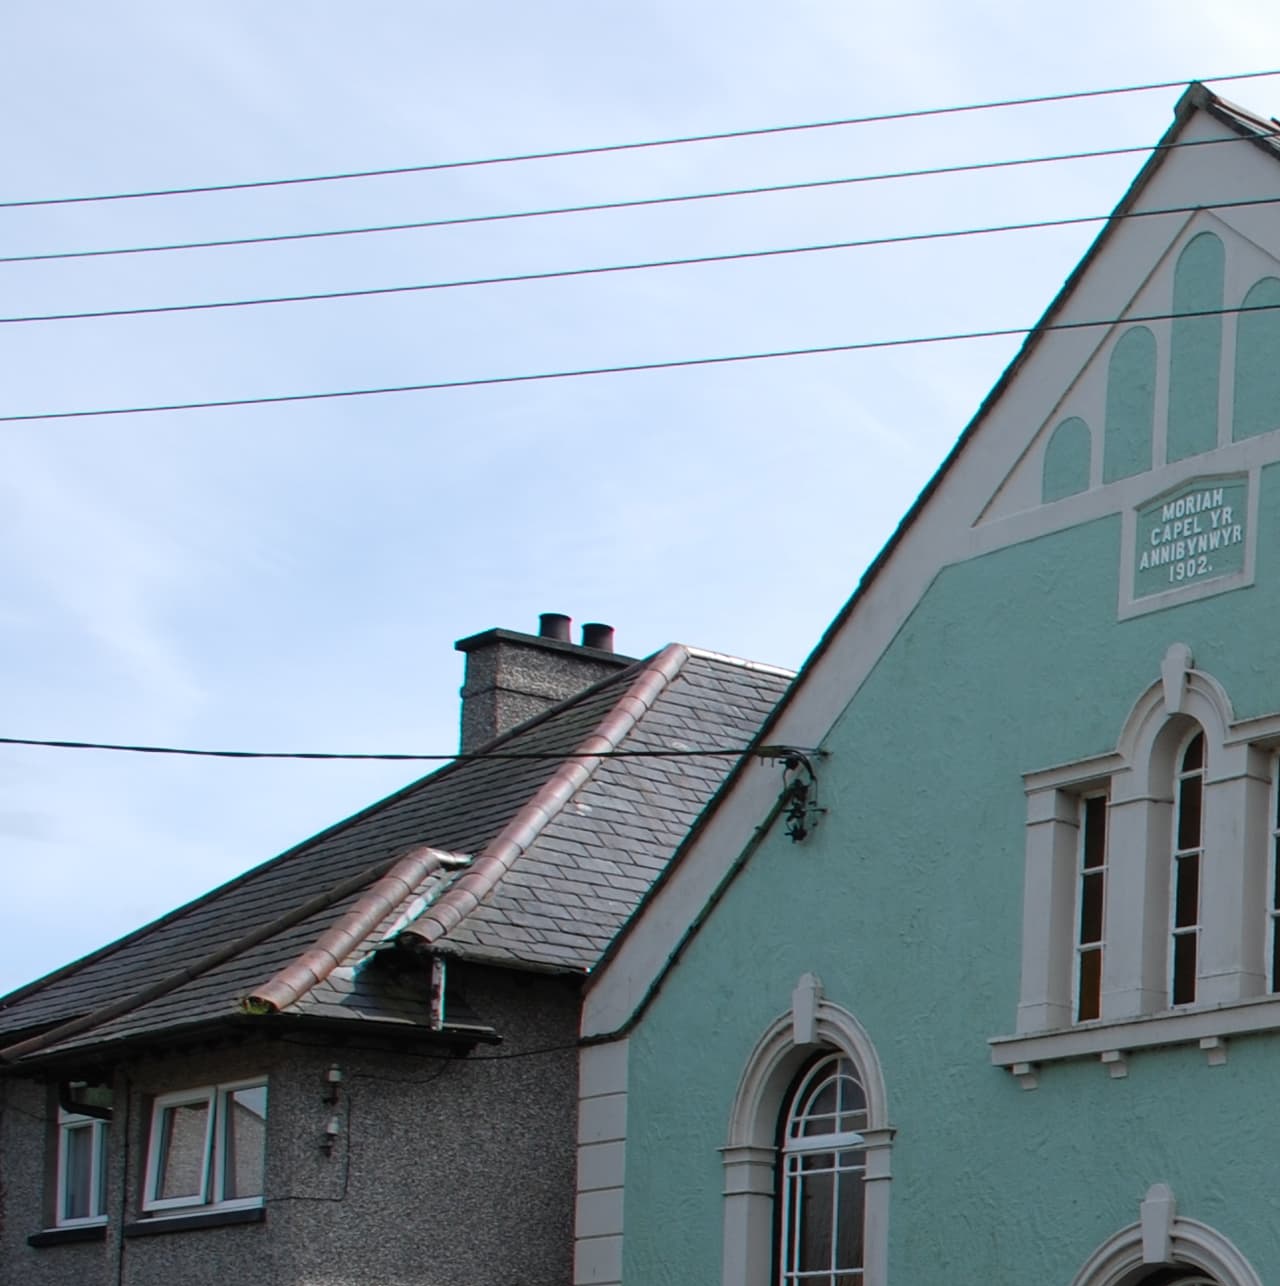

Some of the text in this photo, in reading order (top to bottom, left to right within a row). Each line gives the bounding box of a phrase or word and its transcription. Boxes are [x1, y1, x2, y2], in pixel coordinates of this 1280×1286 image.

[1162, 488, 1224, 522] MORIAH
[1151, 506, 1232, 545] CAPEL YR
[1139, 525, 1242, 570] ANNIBYNWYR
[1169, 556, 1213, 582] 1902.
